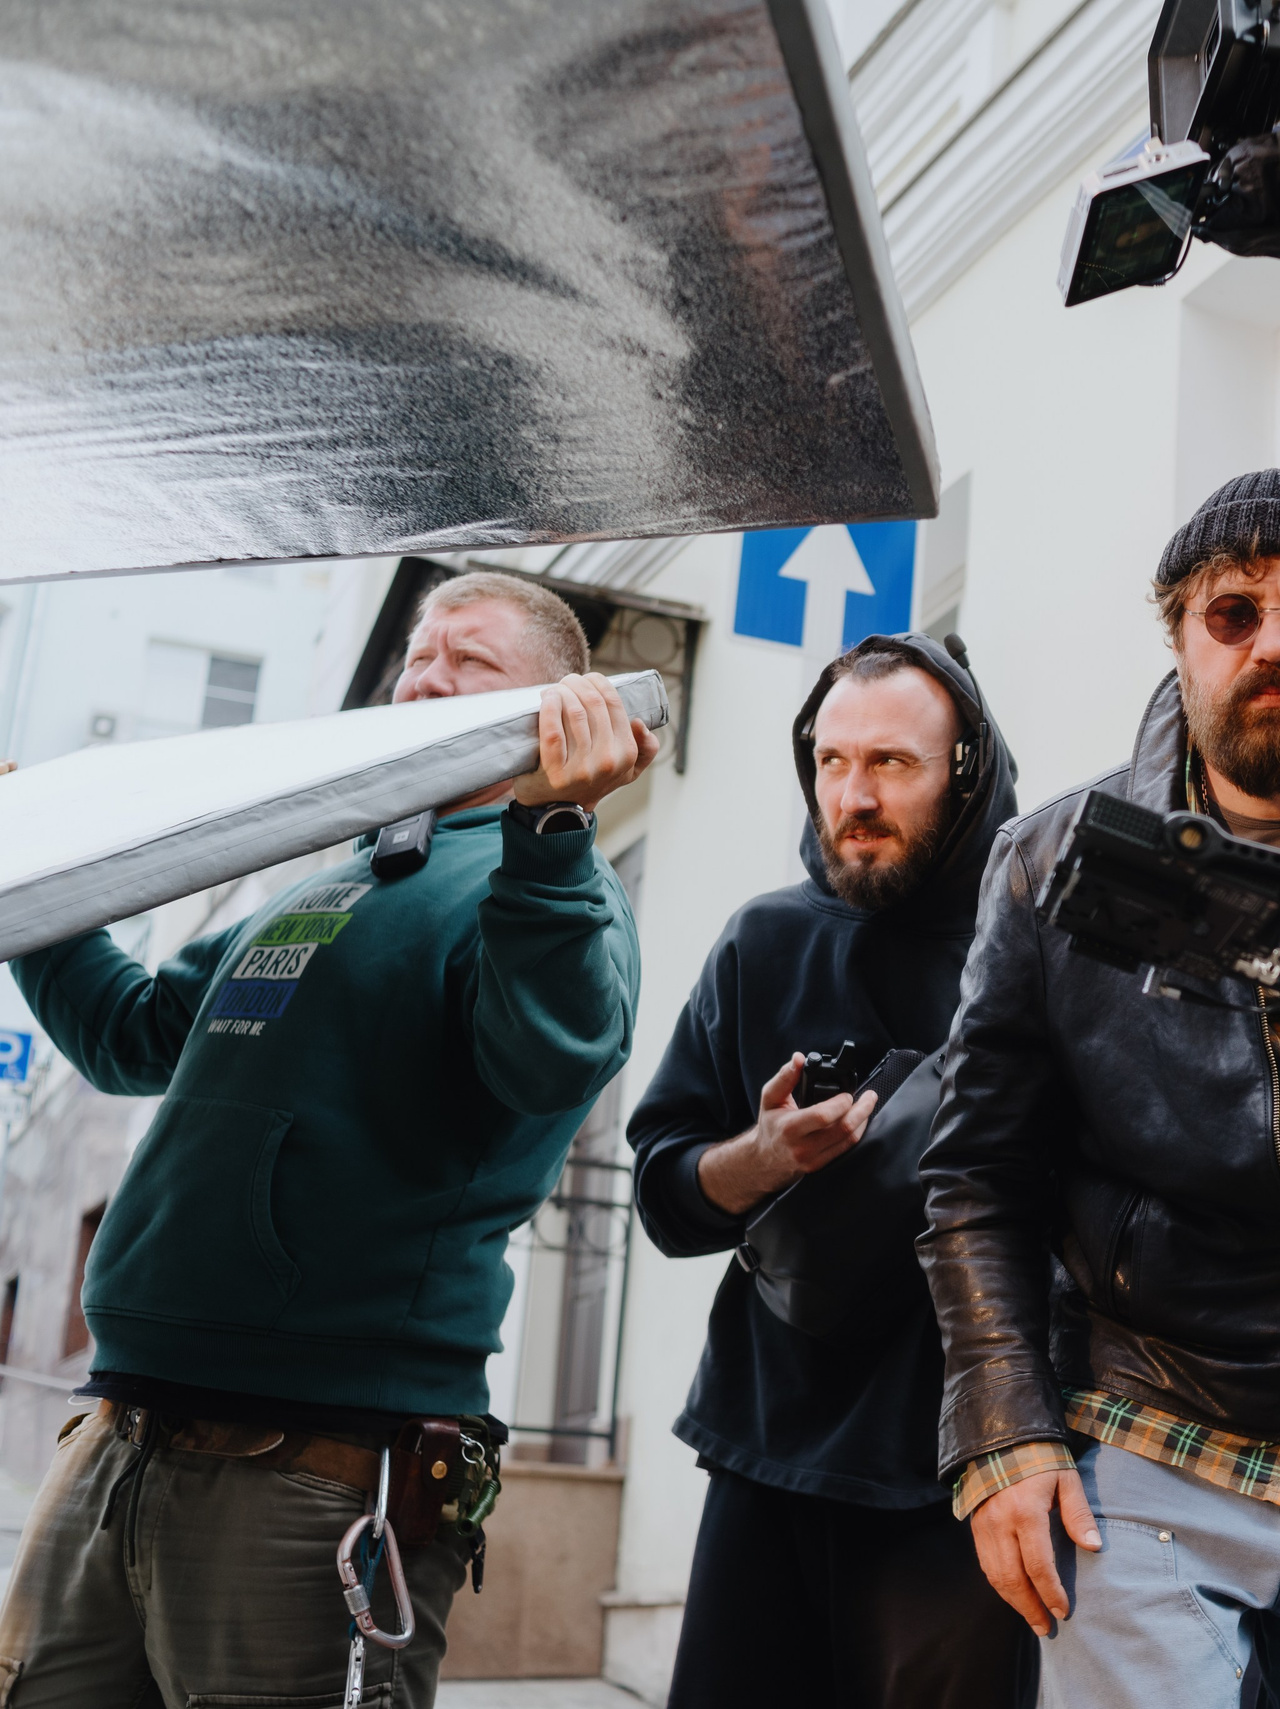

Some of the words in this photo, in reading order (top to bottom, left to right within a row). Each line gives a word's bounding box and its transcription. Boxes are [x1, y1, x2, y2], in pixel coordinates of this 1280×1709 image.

[291, 886, 360, 911] ROME
[259, 919, 303, 941] NEW
[297, 917, 343, 940] YORK
[240, 946, 309, 976] PARIS
[215, 985, 291, 1014] LONDON
[207, 1018, 233, 1034] WAIT
[230, 1019, 252, 1035] FOR
[248, 1021, 267, 1036] ME
